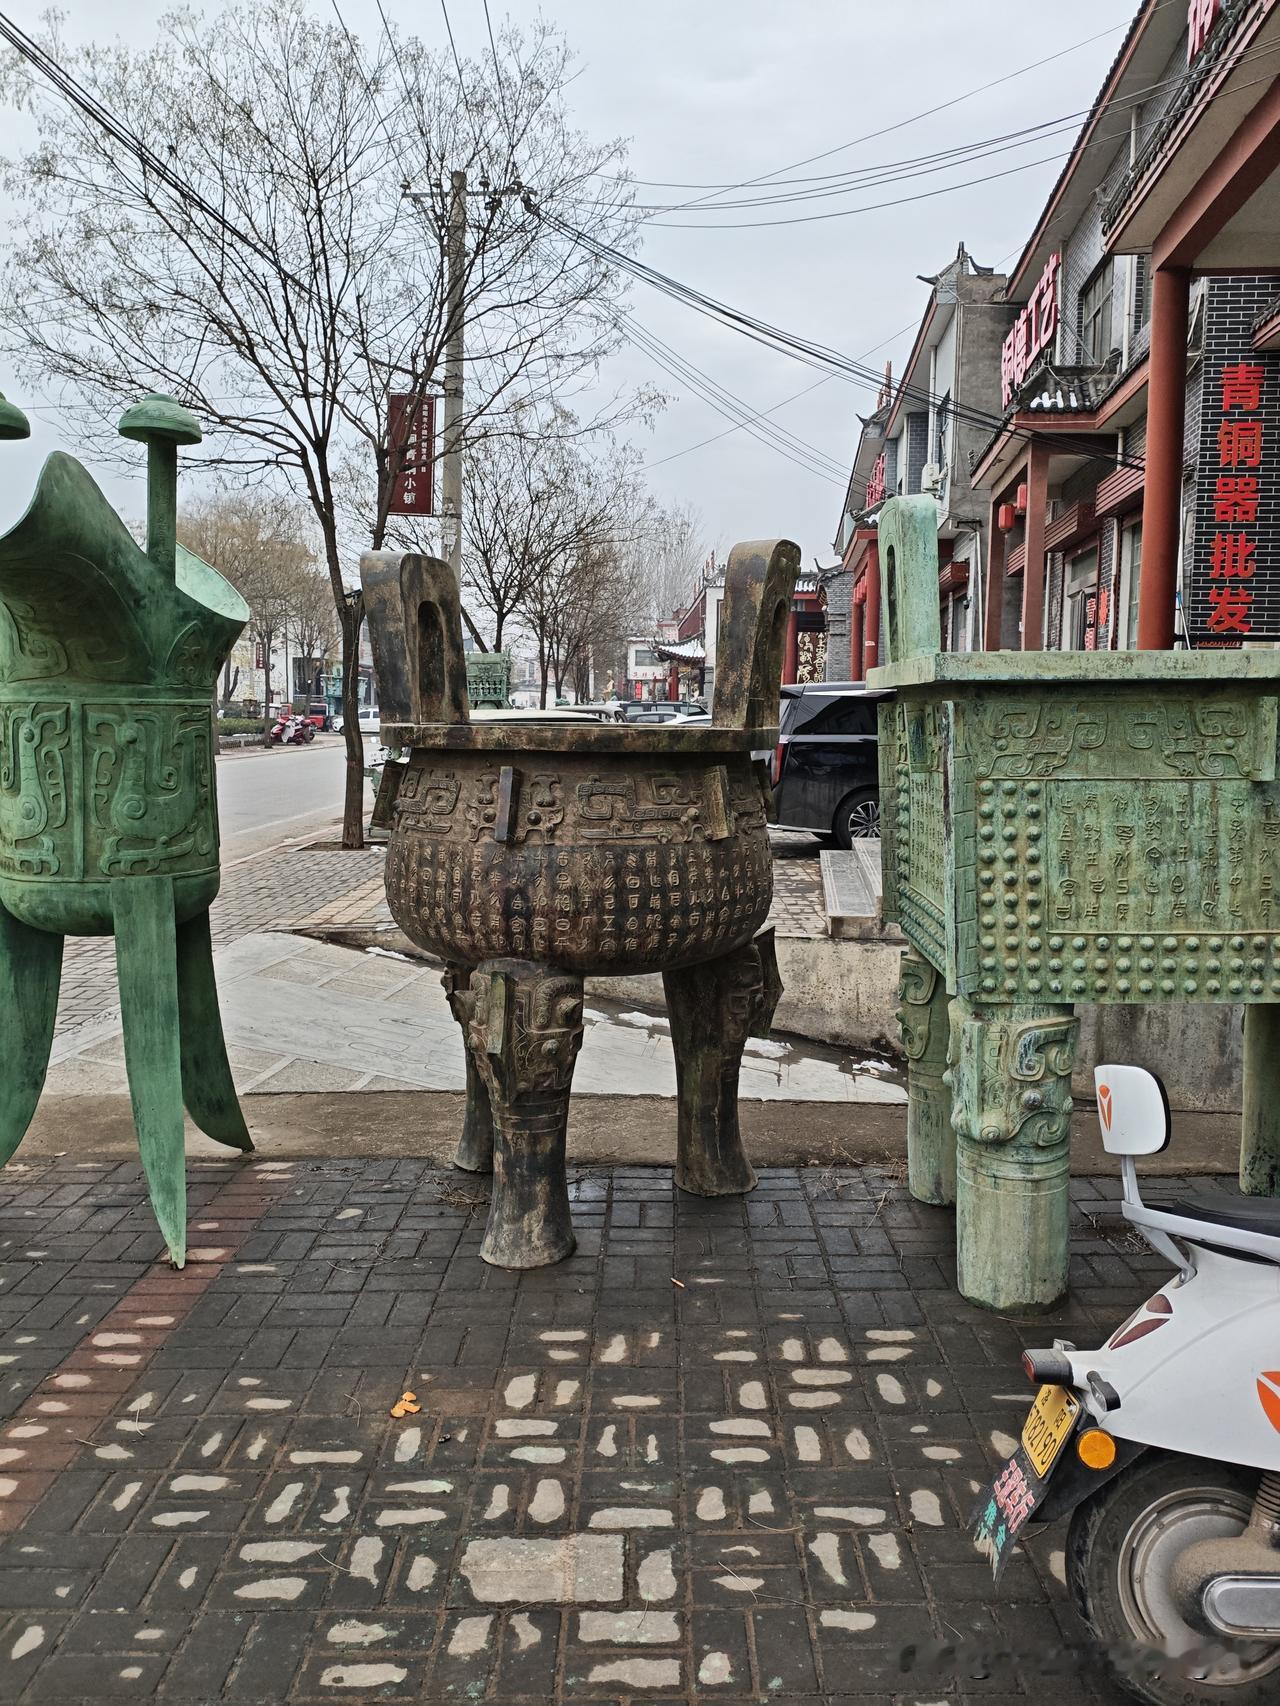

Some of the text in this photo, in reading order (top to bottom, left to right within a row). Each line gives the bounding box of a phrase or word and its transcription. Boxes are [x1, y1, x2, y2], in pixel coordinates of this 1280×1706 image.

[1207, 363, 1264, 633] 青铜器批发
